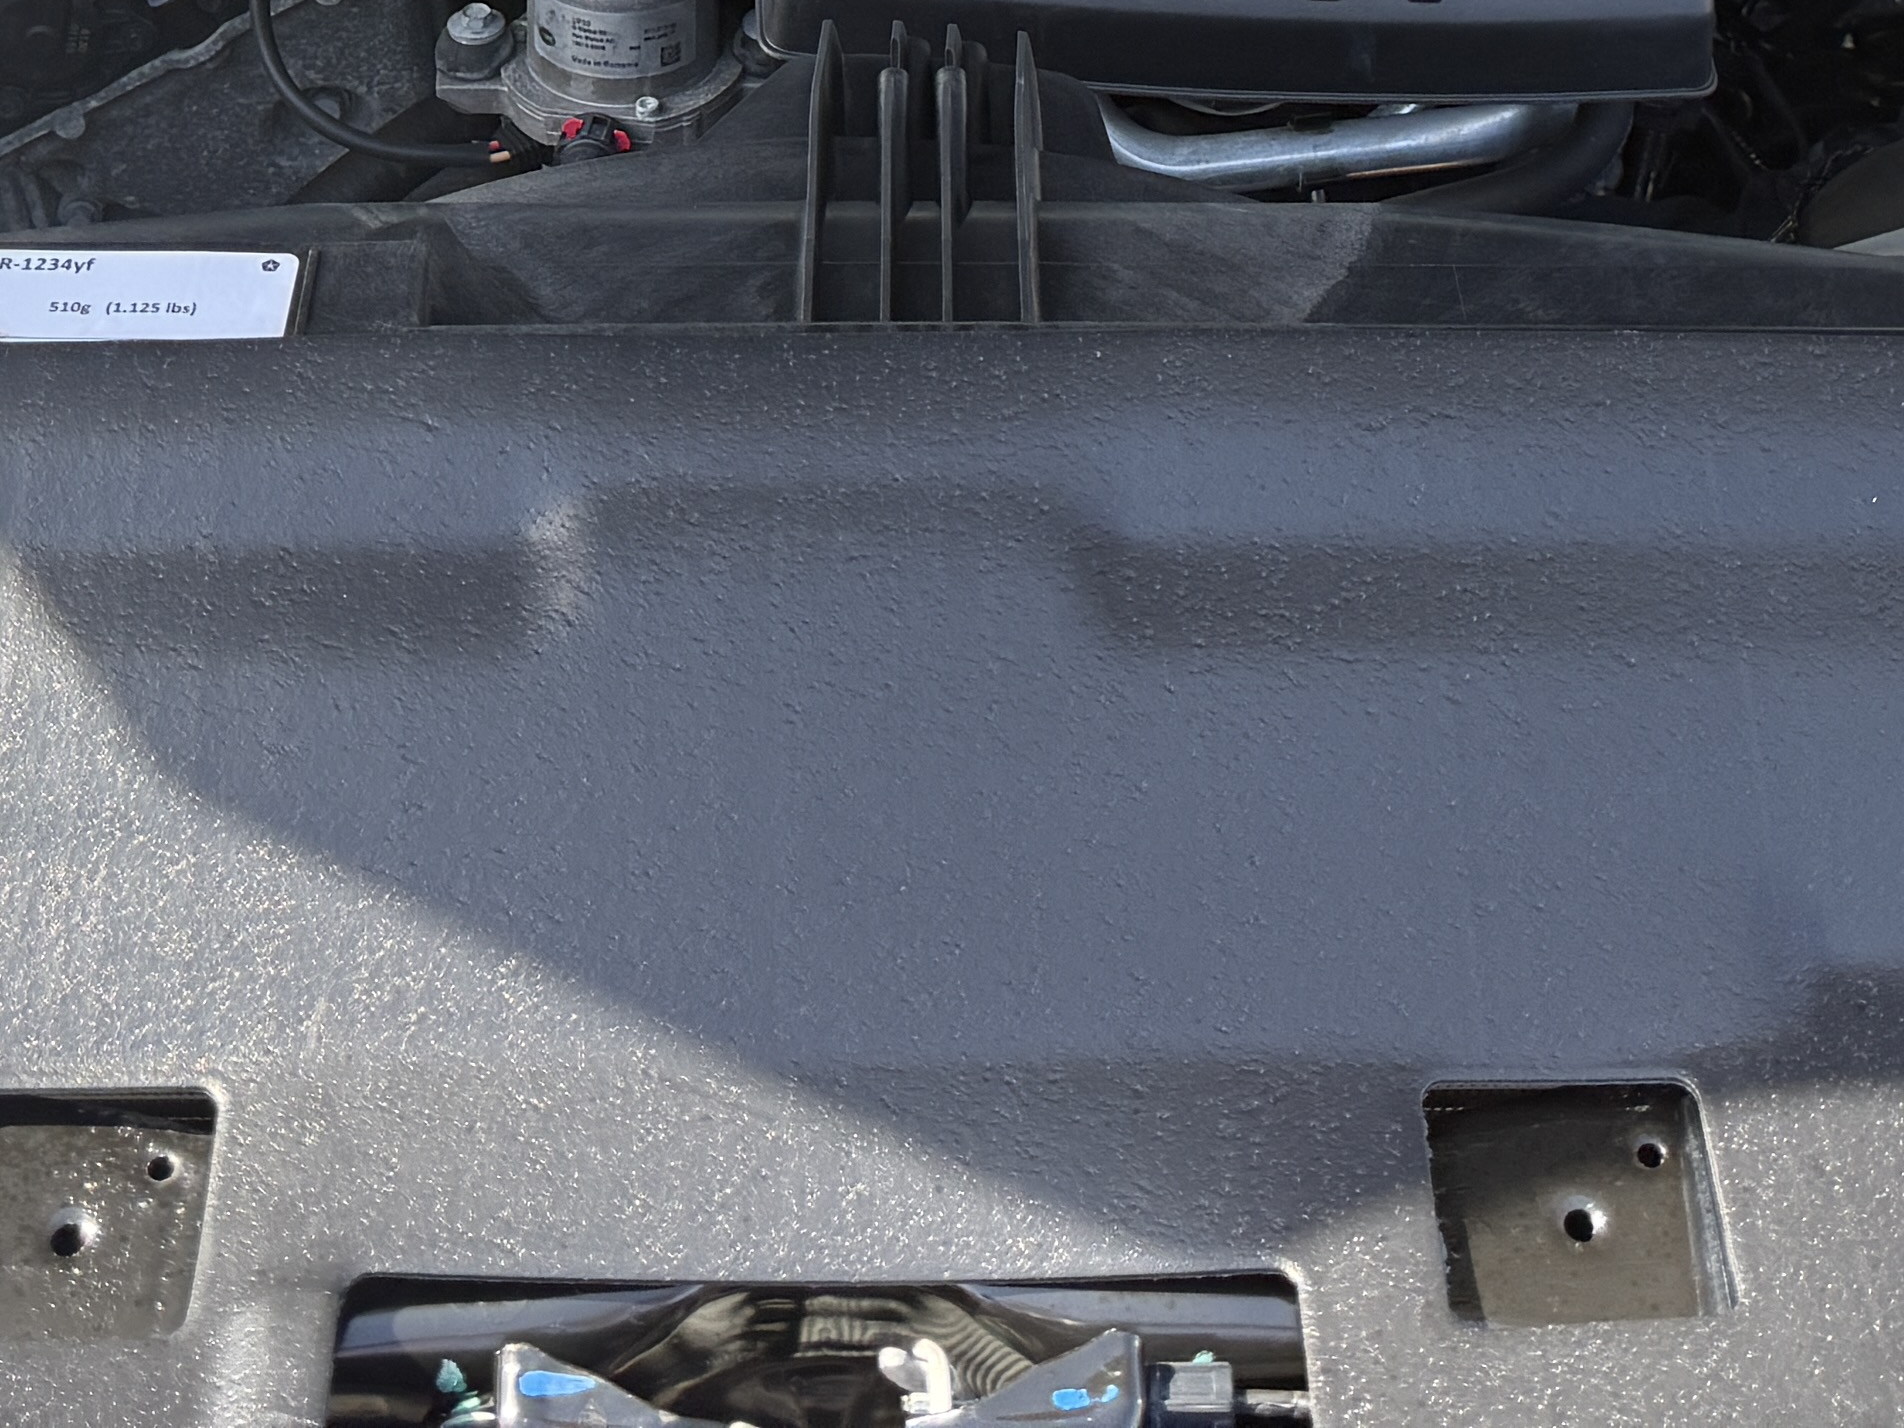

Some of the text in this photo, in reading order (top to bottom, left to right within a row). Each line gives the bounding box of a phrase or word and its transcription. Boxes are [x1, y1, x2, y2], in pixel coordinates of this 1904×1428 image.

[48, 300, 198, 317] 510g (1.125 lbs)
